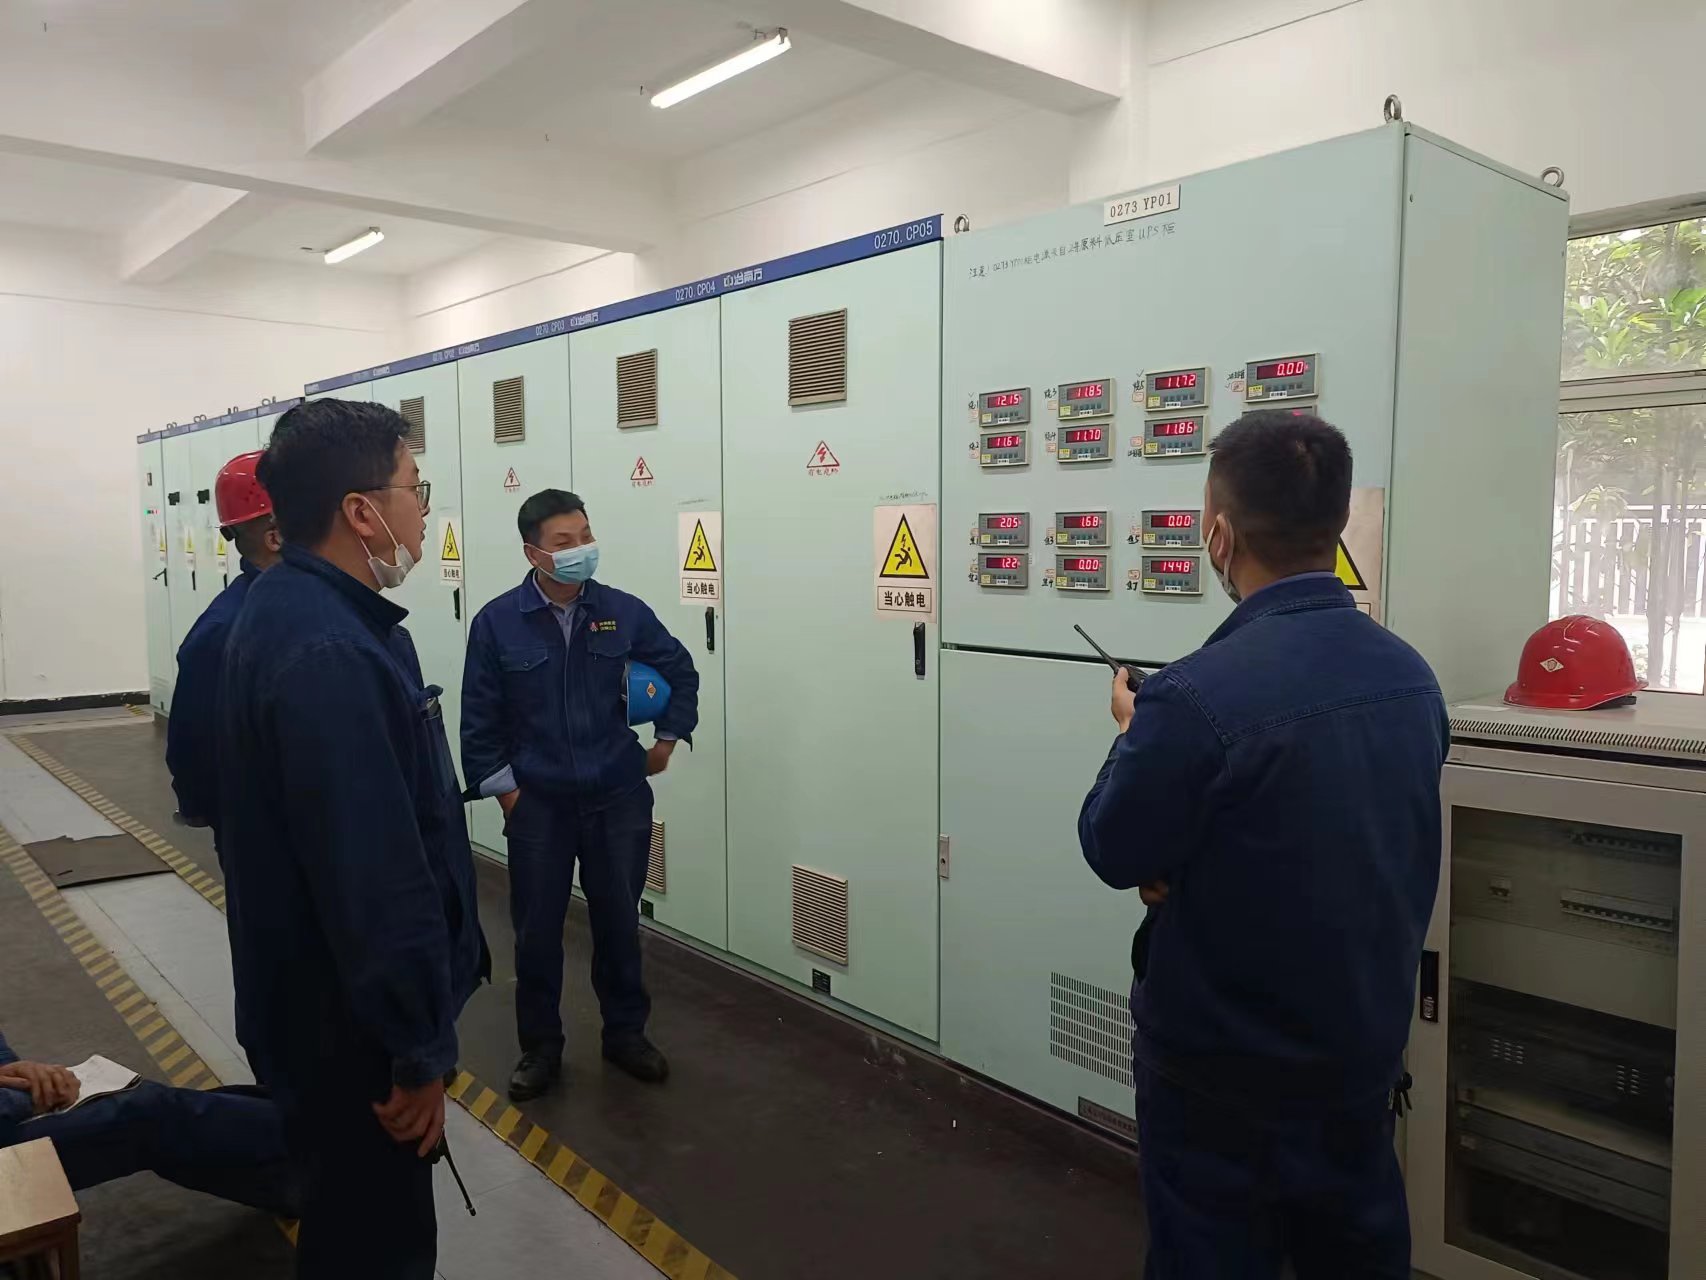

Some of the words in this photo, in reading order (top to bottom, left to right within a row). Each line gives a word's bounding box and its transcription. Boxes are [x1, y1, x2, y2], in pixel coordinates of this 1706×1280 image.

[1110, 201, 1138, 219] 0273
[1143, 192, 1172, 210] YP01
[723, 267, 763, 287] 中冶南方
[686, 581, 716, 596] 当心触电
[884, 590, 926, 608] 当心触电
